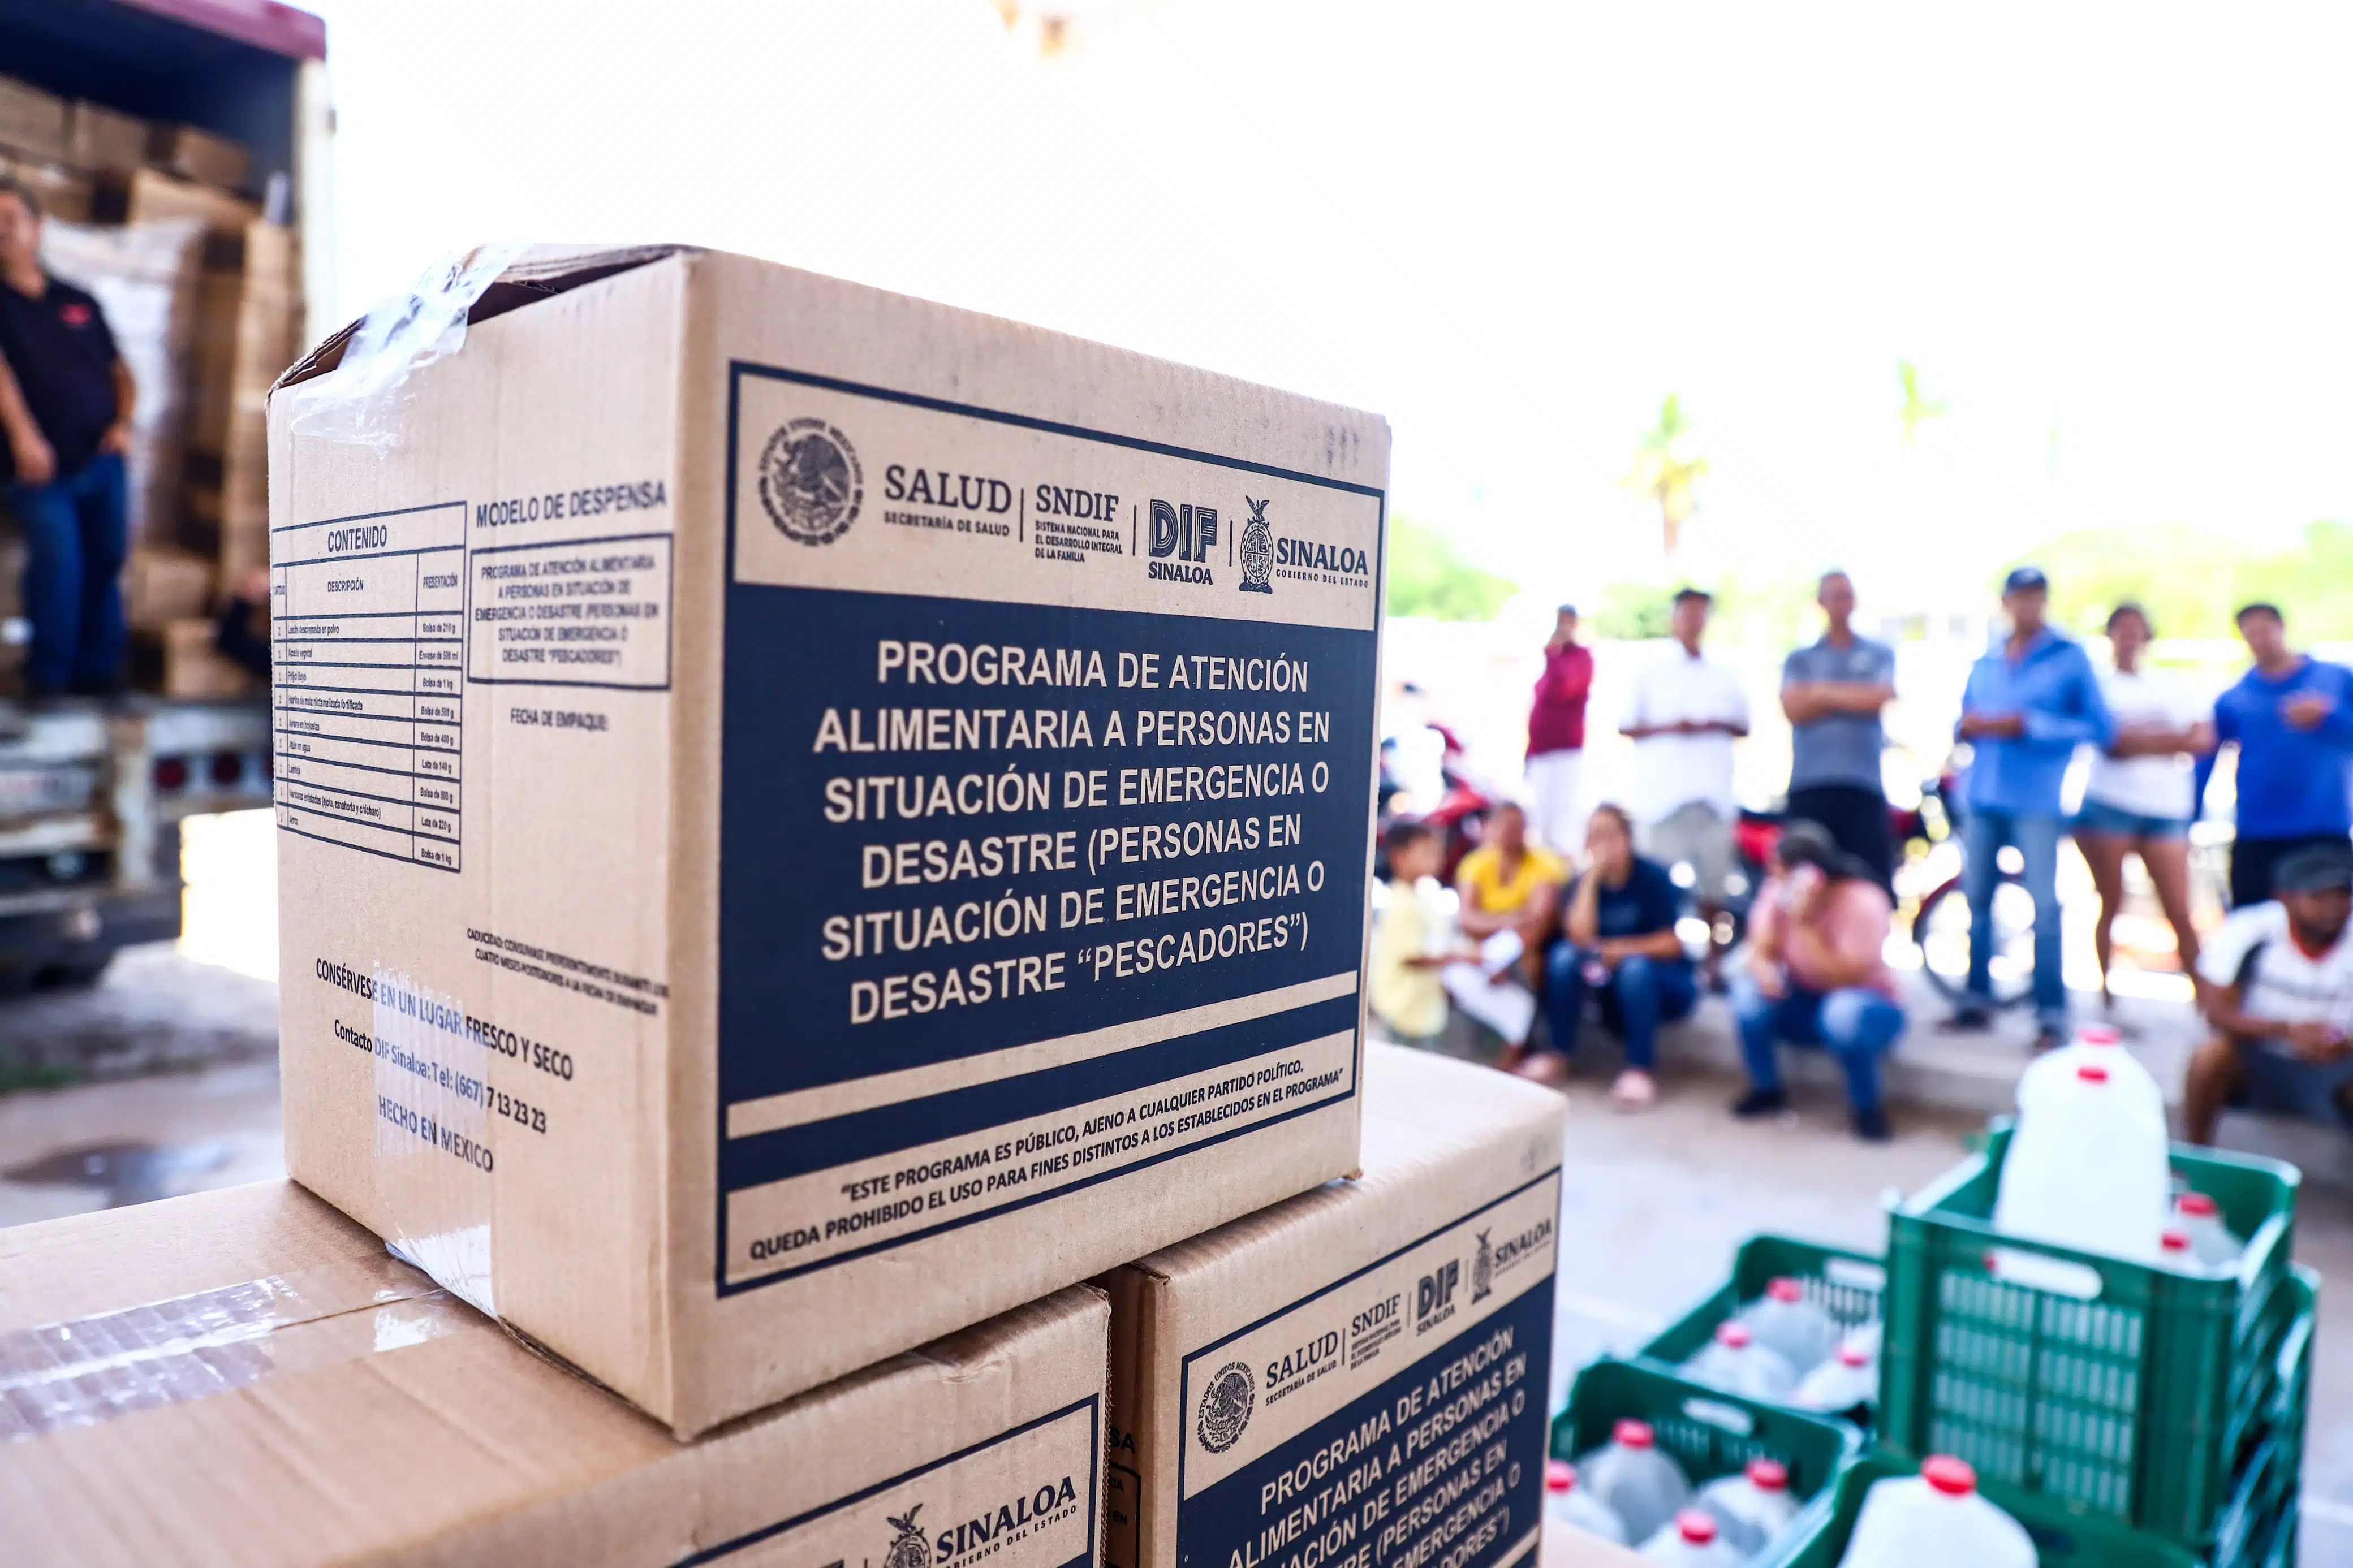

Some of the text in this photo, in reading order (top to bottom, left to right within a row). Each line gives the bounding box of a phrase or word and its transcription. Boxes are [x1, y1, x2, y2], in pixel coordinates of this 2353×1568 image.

[476, 478, 667, 528] MODELO DE DESPENSA
[885, 464, 1012, 514] SALUD
[1036, 484, 1119, 522] SNDIF
[327, 525, 387, 552] CONTENIDO
[884, 511, 1010, 537] SECRETARÍA DE SALUD
[1035, 534, 1123, 555] EL DESARROLLO INTEGRAL
[1036, 520, 1119, 541] SISTEMA NACIONAL PARA
[1149, 499, 1218, 563] DIF
[1035, 547, 1085, 563] DE LA FAMILIA
[1148, 561, 1213, 585] SINALOA
[1277, 537, 1369, 576] SINALOA
[327, 577, 364, 593] DESCRIPCIÓN
[423, 572, 458, 589] PRESENTACIÓN
[1277, 568, 1369, 588] GOBIERNO DEL ESTADO
[327, 624, 339, 636] polvo
[419, 650, 436, 660] Envase
[437, 651, 442, 660] de
[878, 640, 1308, 693] PROGRAMA DE ATENCIÓN
[341, 699, 363, 710] fortificada
[423, 678, 453, 691] Bolsa de 1 kg
[510, 708, 539, 724] FECHA
[541, 710, 554, 728] DE
[813, 707, 1329, 754] ALIMENTARIA A PERSONAS EN
[421, 759, 452, 775] Lata de 140 g
[335, 800, 355, 813] zanahoria
[355, 805, 359, 815] y
[823, 761, 1329, 824] SITUACIÓN DE EMERGENCIA O
[421, 817, 451, 833] Lata de 220 g
[421, 848, 451, 866] Bolsa de 1 kg
[861, 814, 1302, 889] DESASTRE (PERSONAS EN
[820, 859, 1325, 962] SITUACIÓN DE EMERGENCIA O
[850, 912, 1309, 1024] DESASTRE “PESCADORES”)
[316, 957, 573, 1081] CONSÉRVESE EN UN LUGAR FRESCO Y SECO
[334, 1018, 546, 1134] Contacto DIF Sinaloa: Tel: (667) 7 13 23 23
[378, 1094, 493, 1173] HECHO EN MEXICO
[841, 1060, 1304, 1202] “ESTE PROGRAMA ES PÚBLICO, AJENO A CUALQUIER PARTIDO POLÍTICO.
[750, 1225, 820, 1261] QUEDA
[826, 1194, 924, 1239] PROHIBIDO
[928, 1187, 946, 1208] EL
[950, 1177, 983, 1203] USO
[987, 1164, 1027, 1193] PARA
[1030, 1151, 1070, 1181] FINES
[1072, 1133, 1139, 1170] DISTINTOS
[1141, 1129, 1151, 1145] A
[1153, 1119, 1176, 1142] LOS
[1177, 1094, 1256, 1134] ESTABLECIDOS
[1257, 1088, 1270, 1108] EN
[1273, 1083, 1284, 1103] EL
[1494, 1217, 1552, 1268] SINALOA
[1417, 1258, 1459, 1320] DIF
[1352, 1293, 1401, 1337] SNDIF
[1416, 1303, 1455, 1337] SINALOA
[1265, 1359, 1337, 1406] SECRETARÍA DE SALUD
[1266, 1331, 1338, 1389] SALUD
[1198, 1362, 1255, 1420] ESTADOS UNIDOS MEXICANOS
[1261, 1409, 1392, 1515] PROGRAMA
[1397, 1386, 1423, 1427] DE
[1427, 1325, 1515, 1399] ATENCIÓN
[1229, 1456, 1382, 1568] ALIMENTARIA
[1387, 1442, 1402, 1474] A
[1406, 1370, 1503, 1460] PERSONAS
[1505, 1351, 1527, 1388] EN
[1363, 1488, 1390, 1531] DE
[1395, 1405, 1510, 1507] EMERGENCIA
[1512, 1389, 1526, 1416] O
[1508, 1462, 1521, 1488] O
[936, 1476, 1076, 1564] SINALOA
[1376, 1458, 1481, 1566] (PERSONAS
[1484, 1438, 1507, 1475] EN
[1007, 1528, 1028, 1547] DEL
[1034, 1505, 1077, 1532] ESTADO
